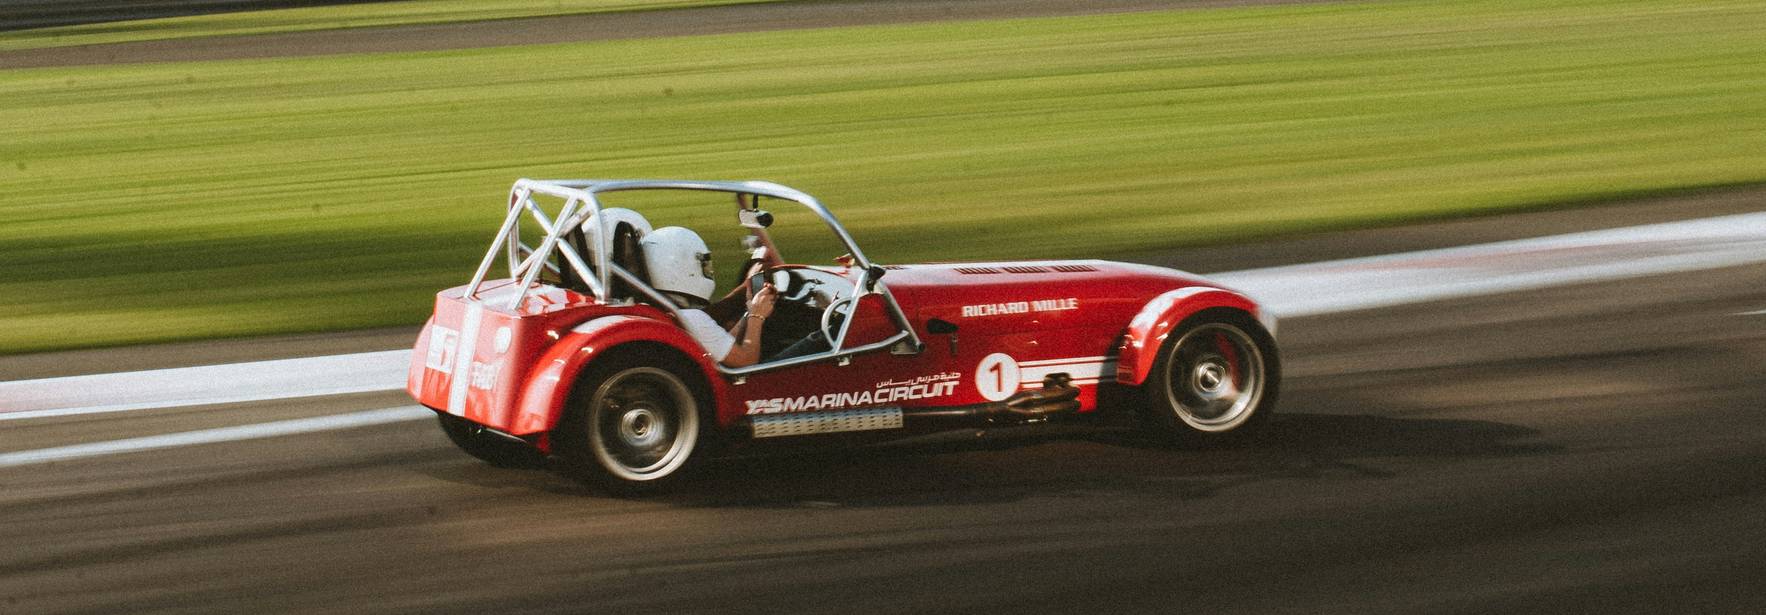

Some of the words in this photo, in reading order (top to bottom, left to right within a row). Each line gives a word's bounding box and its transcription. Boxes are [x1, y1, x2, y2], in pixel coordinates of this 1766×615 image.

[962, 301, 1029, 317] RICHARD
[1031, 298, 1078, 312] MILLE
[989, 361, 1003, 392] 1
